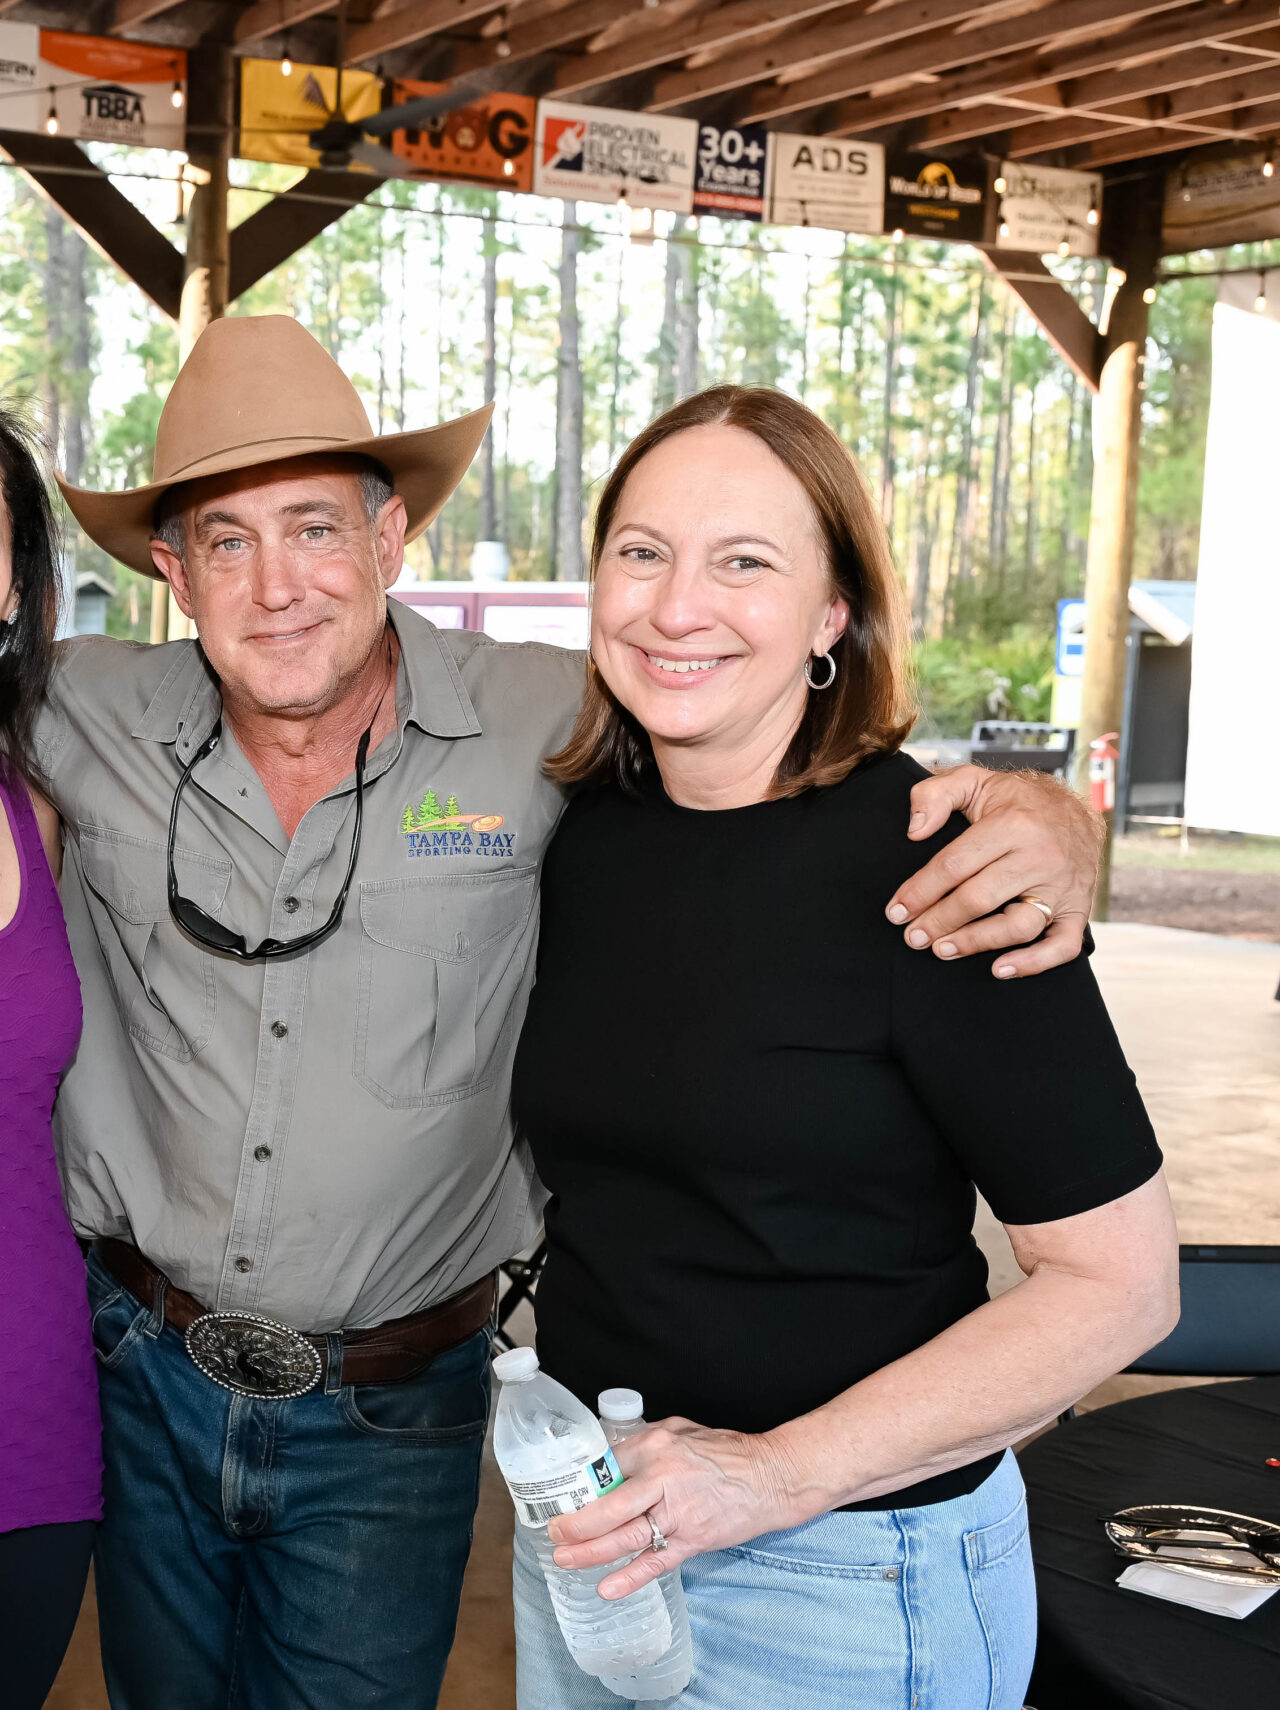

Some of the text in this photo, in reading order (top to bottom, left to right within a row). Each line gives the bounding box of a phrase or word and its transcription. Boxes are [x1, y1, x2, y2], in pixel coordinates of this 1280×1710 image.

[83, 92, 145, 125] TBBA
[589, 121, 660, 145] PROVEN
[699, 126, 764, 163] 30+
[584, 138, 688, 169] ELECTRICAL
[792, 145, 868, 175] ADS
[700, 157, 760, 188] Years
[408, 832, 515, 848] TAMPA BAY
[408, 847, 513, 857] SPORTING CLAYS
